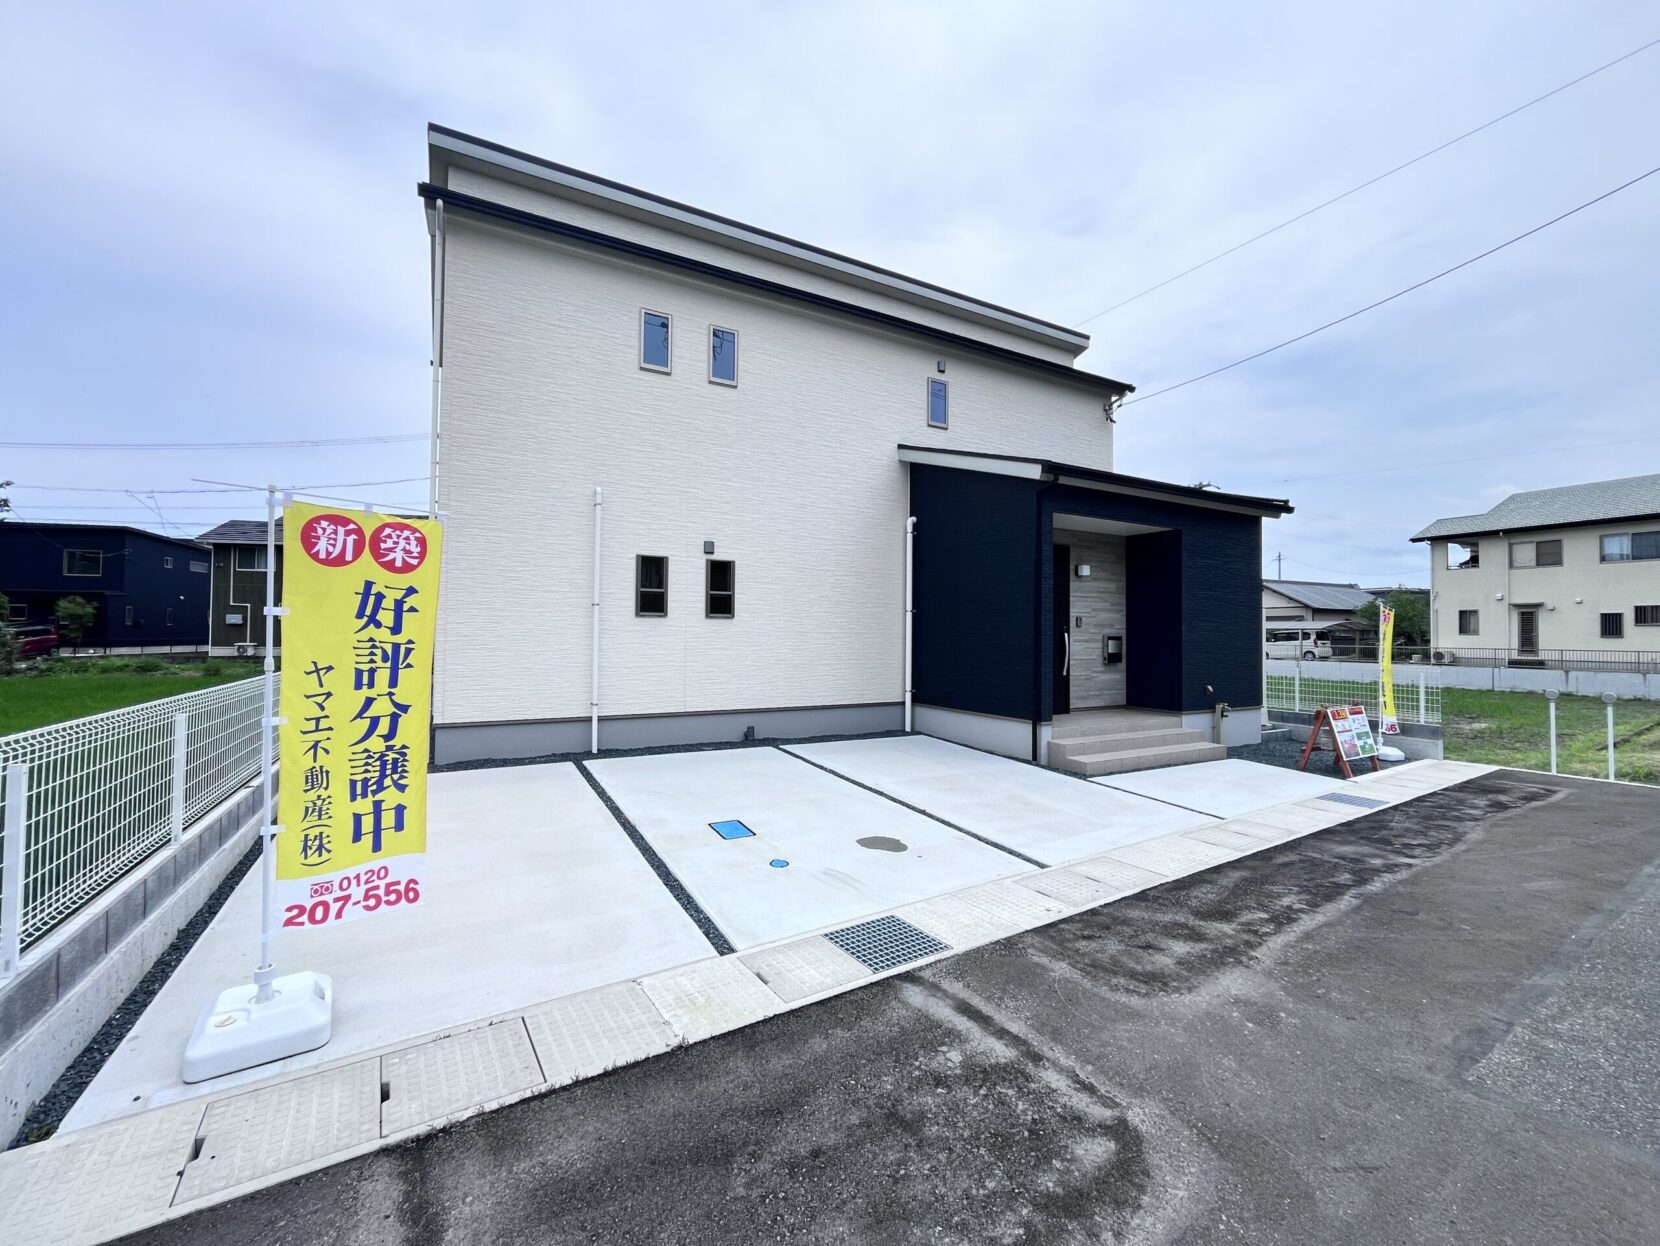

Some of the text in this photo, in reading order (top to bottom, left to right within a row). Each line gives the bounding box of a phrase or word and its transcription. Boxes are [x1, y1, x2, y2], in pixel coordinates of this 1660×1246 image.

[310, 519, 422, 567] 新築
[349, 579, 420, 853] 好評分譲中
[282, 878, 420, 928] 207-556
[338, 865, 389, 892] 0120
